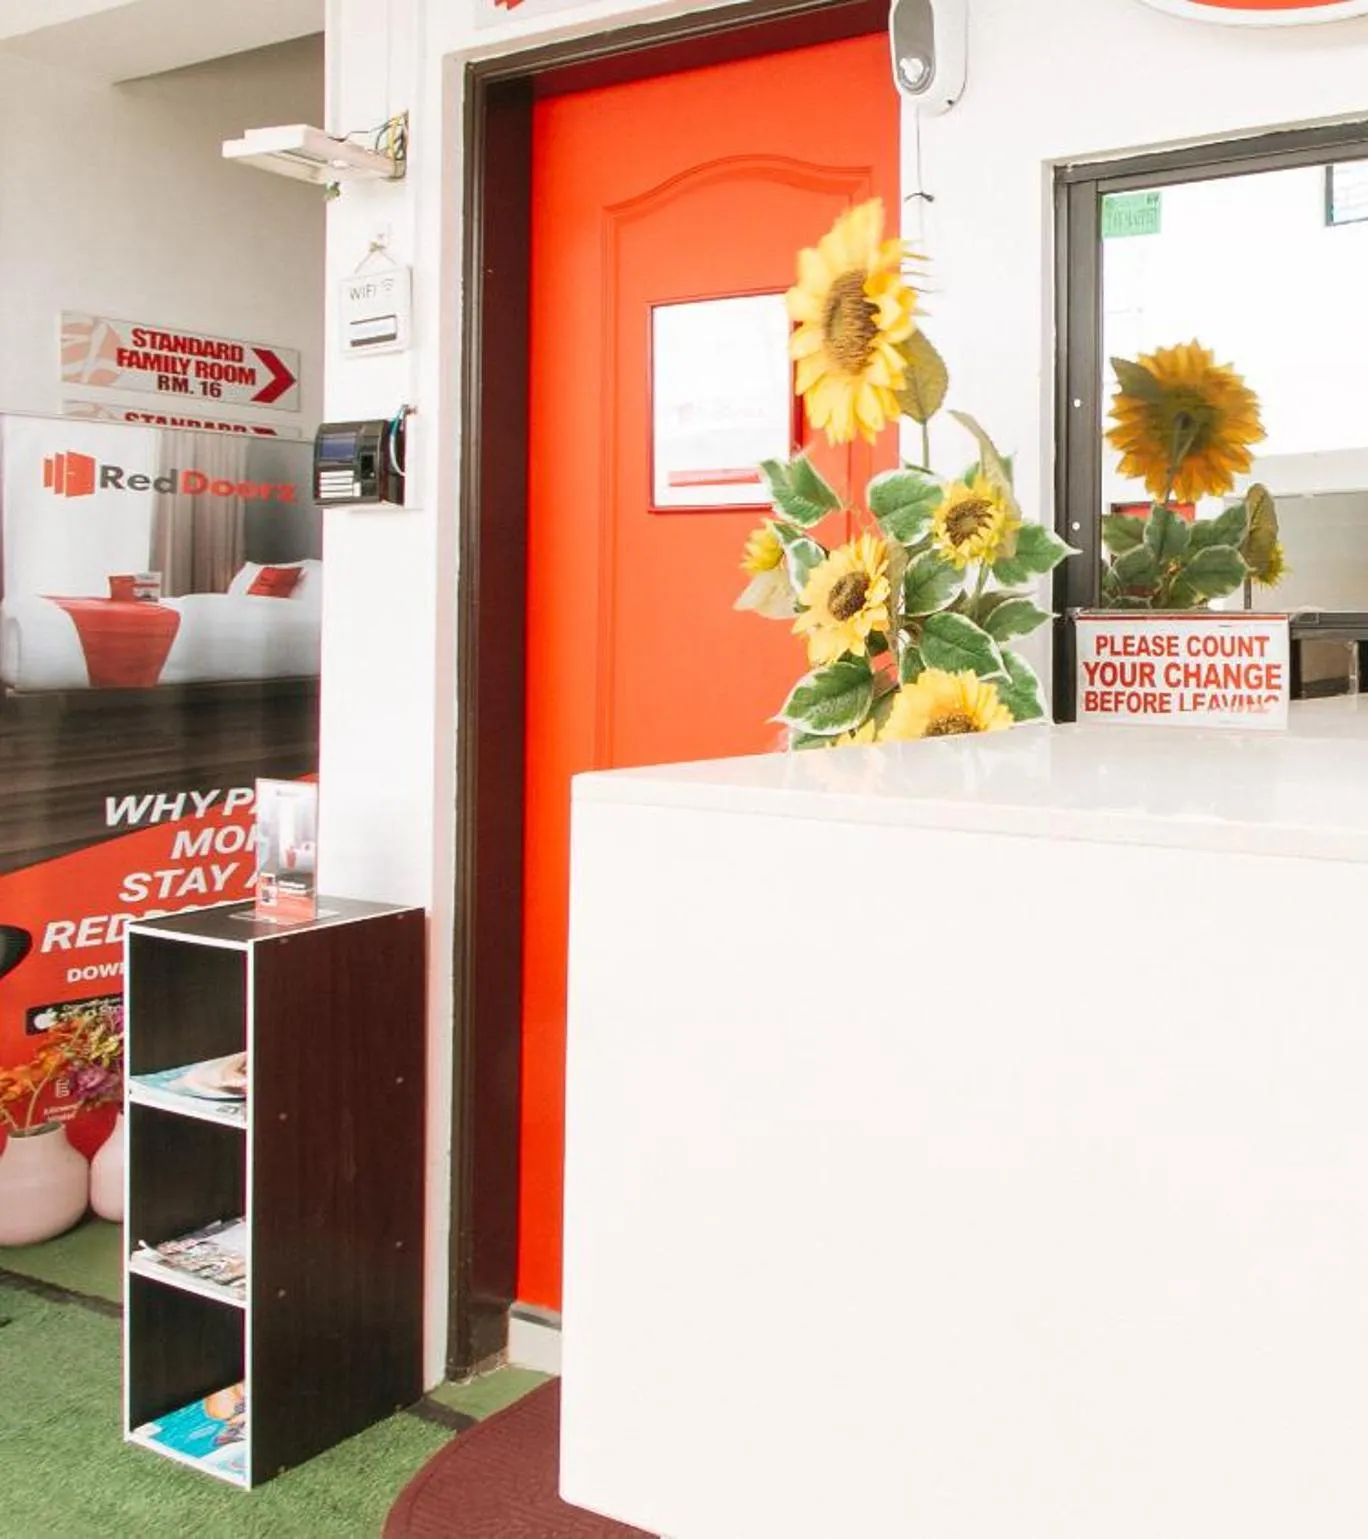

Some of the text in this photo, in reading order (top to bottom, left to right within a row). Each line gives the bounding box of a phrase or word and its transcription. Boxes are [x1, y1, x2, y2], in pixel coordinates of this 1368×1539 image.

[131, 328, 244, 363] STANDARD
[116, 347, 257, 386] FAMILY ROOM
[157, 374, 223, 398] RM. 16
[99, 464, 297, 503] RedDoorz
[1095, 635, 1270, 657] PLEASE COUNT
[1083, 661, 1283, 690] YOUR CHANGE
[1085, 691, 1172, 714] BEFORE
[105, 788, 221, 827] WHY
[118, 862, 240, 902] STAY
